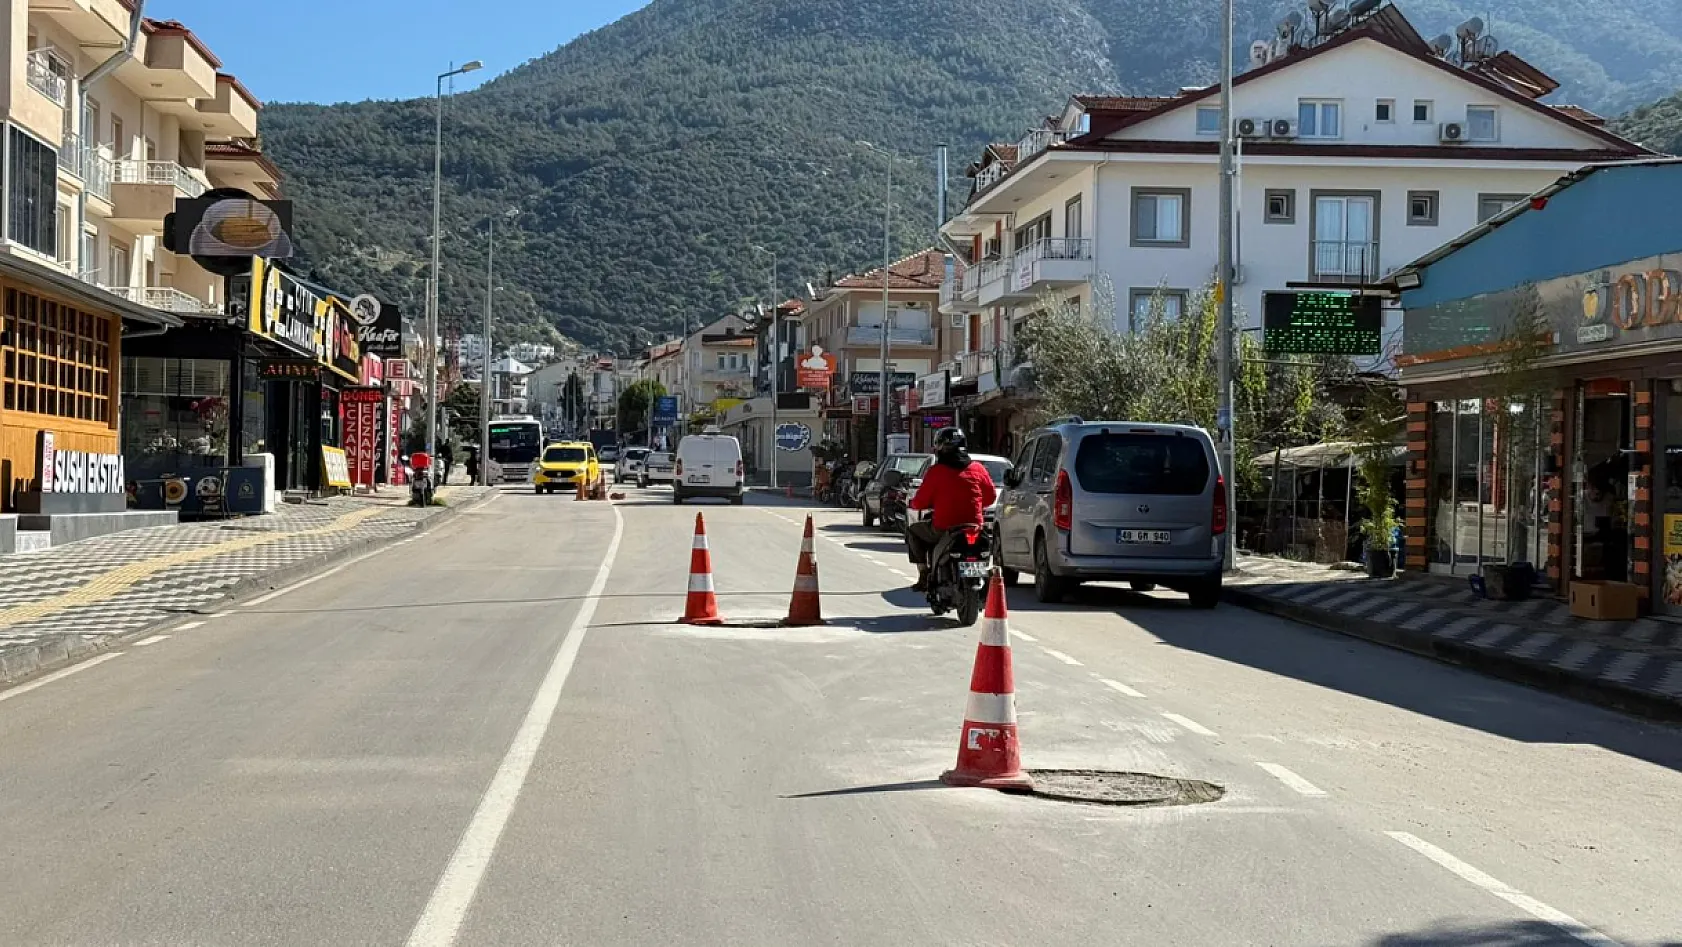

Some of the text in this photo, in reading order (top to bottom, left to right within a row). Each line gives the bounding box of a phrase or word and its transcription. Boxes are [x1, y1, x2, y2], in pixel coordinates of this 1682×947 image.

[343, 389, 382, 401] DÖNER
[361, 403, 372, 470] ECZANE
[53, 449, 87, 493] SUSHI
[87, 452, 125, 493] EKSTRA
[1122, 531, 1132, 540] 48
